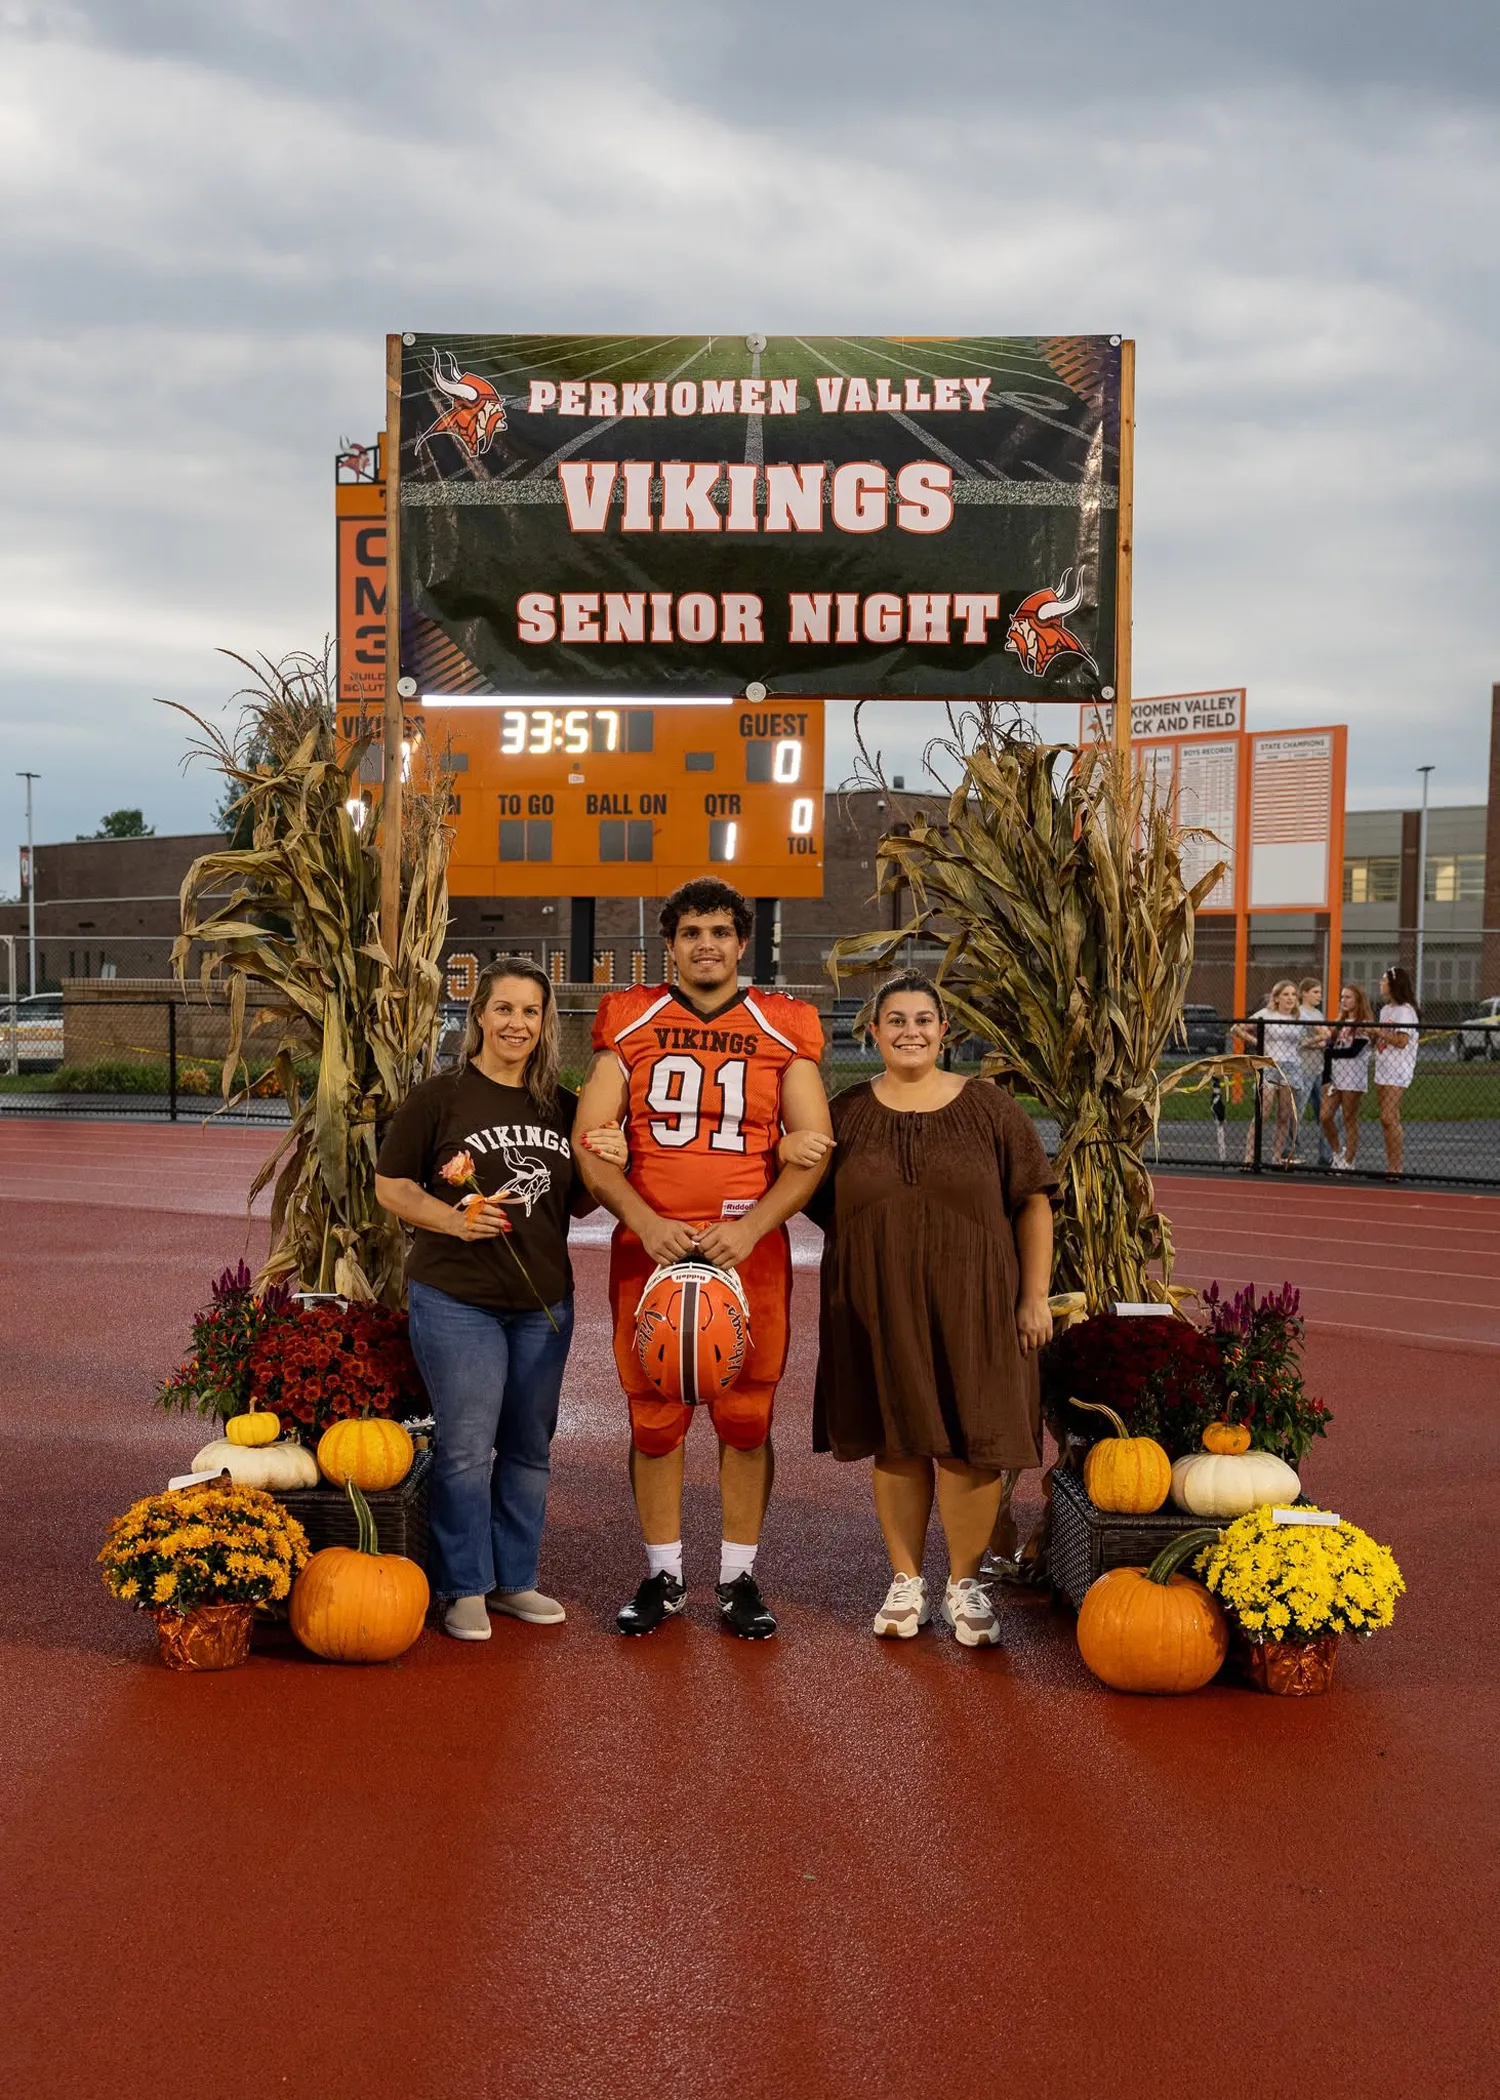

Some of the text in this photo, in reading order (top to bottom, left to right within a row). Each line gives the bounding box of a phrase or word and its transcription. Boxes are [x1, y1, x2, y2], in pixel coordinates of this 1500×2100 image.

[528, 377, 992, 417] PERKIOMEN VALLEY
[558, 460, 954, 534] VIKINGS
[517, 592, 999, 645] SENIOR NIGHT
[1106, 696, 1237, 721] PKIOMEN VALLEY
[1157, 717, 1189, 733] AND
[1192, 712, 1236, 729] FIELD
[501, 711, 618, 754] 33:57
[740, 714, 808, 737] GUEST
[1260, 738, 1325, 751] STATE CHAMPIONS
[773, 740, 801, 783] 0
[498, 794, 554, 815] TO GO
[586, 793, 667, 815] BALL ON
[704, 793, 742, 817] QTR
[791, 798, 814, 834] 0
[787, 837, 817, 855] TOL
[654, 1028, 758, 1056] VIKINGS
[644, 1052, 748, 1155] 91
[464, 1125, 571, 1160] VIKINGS
